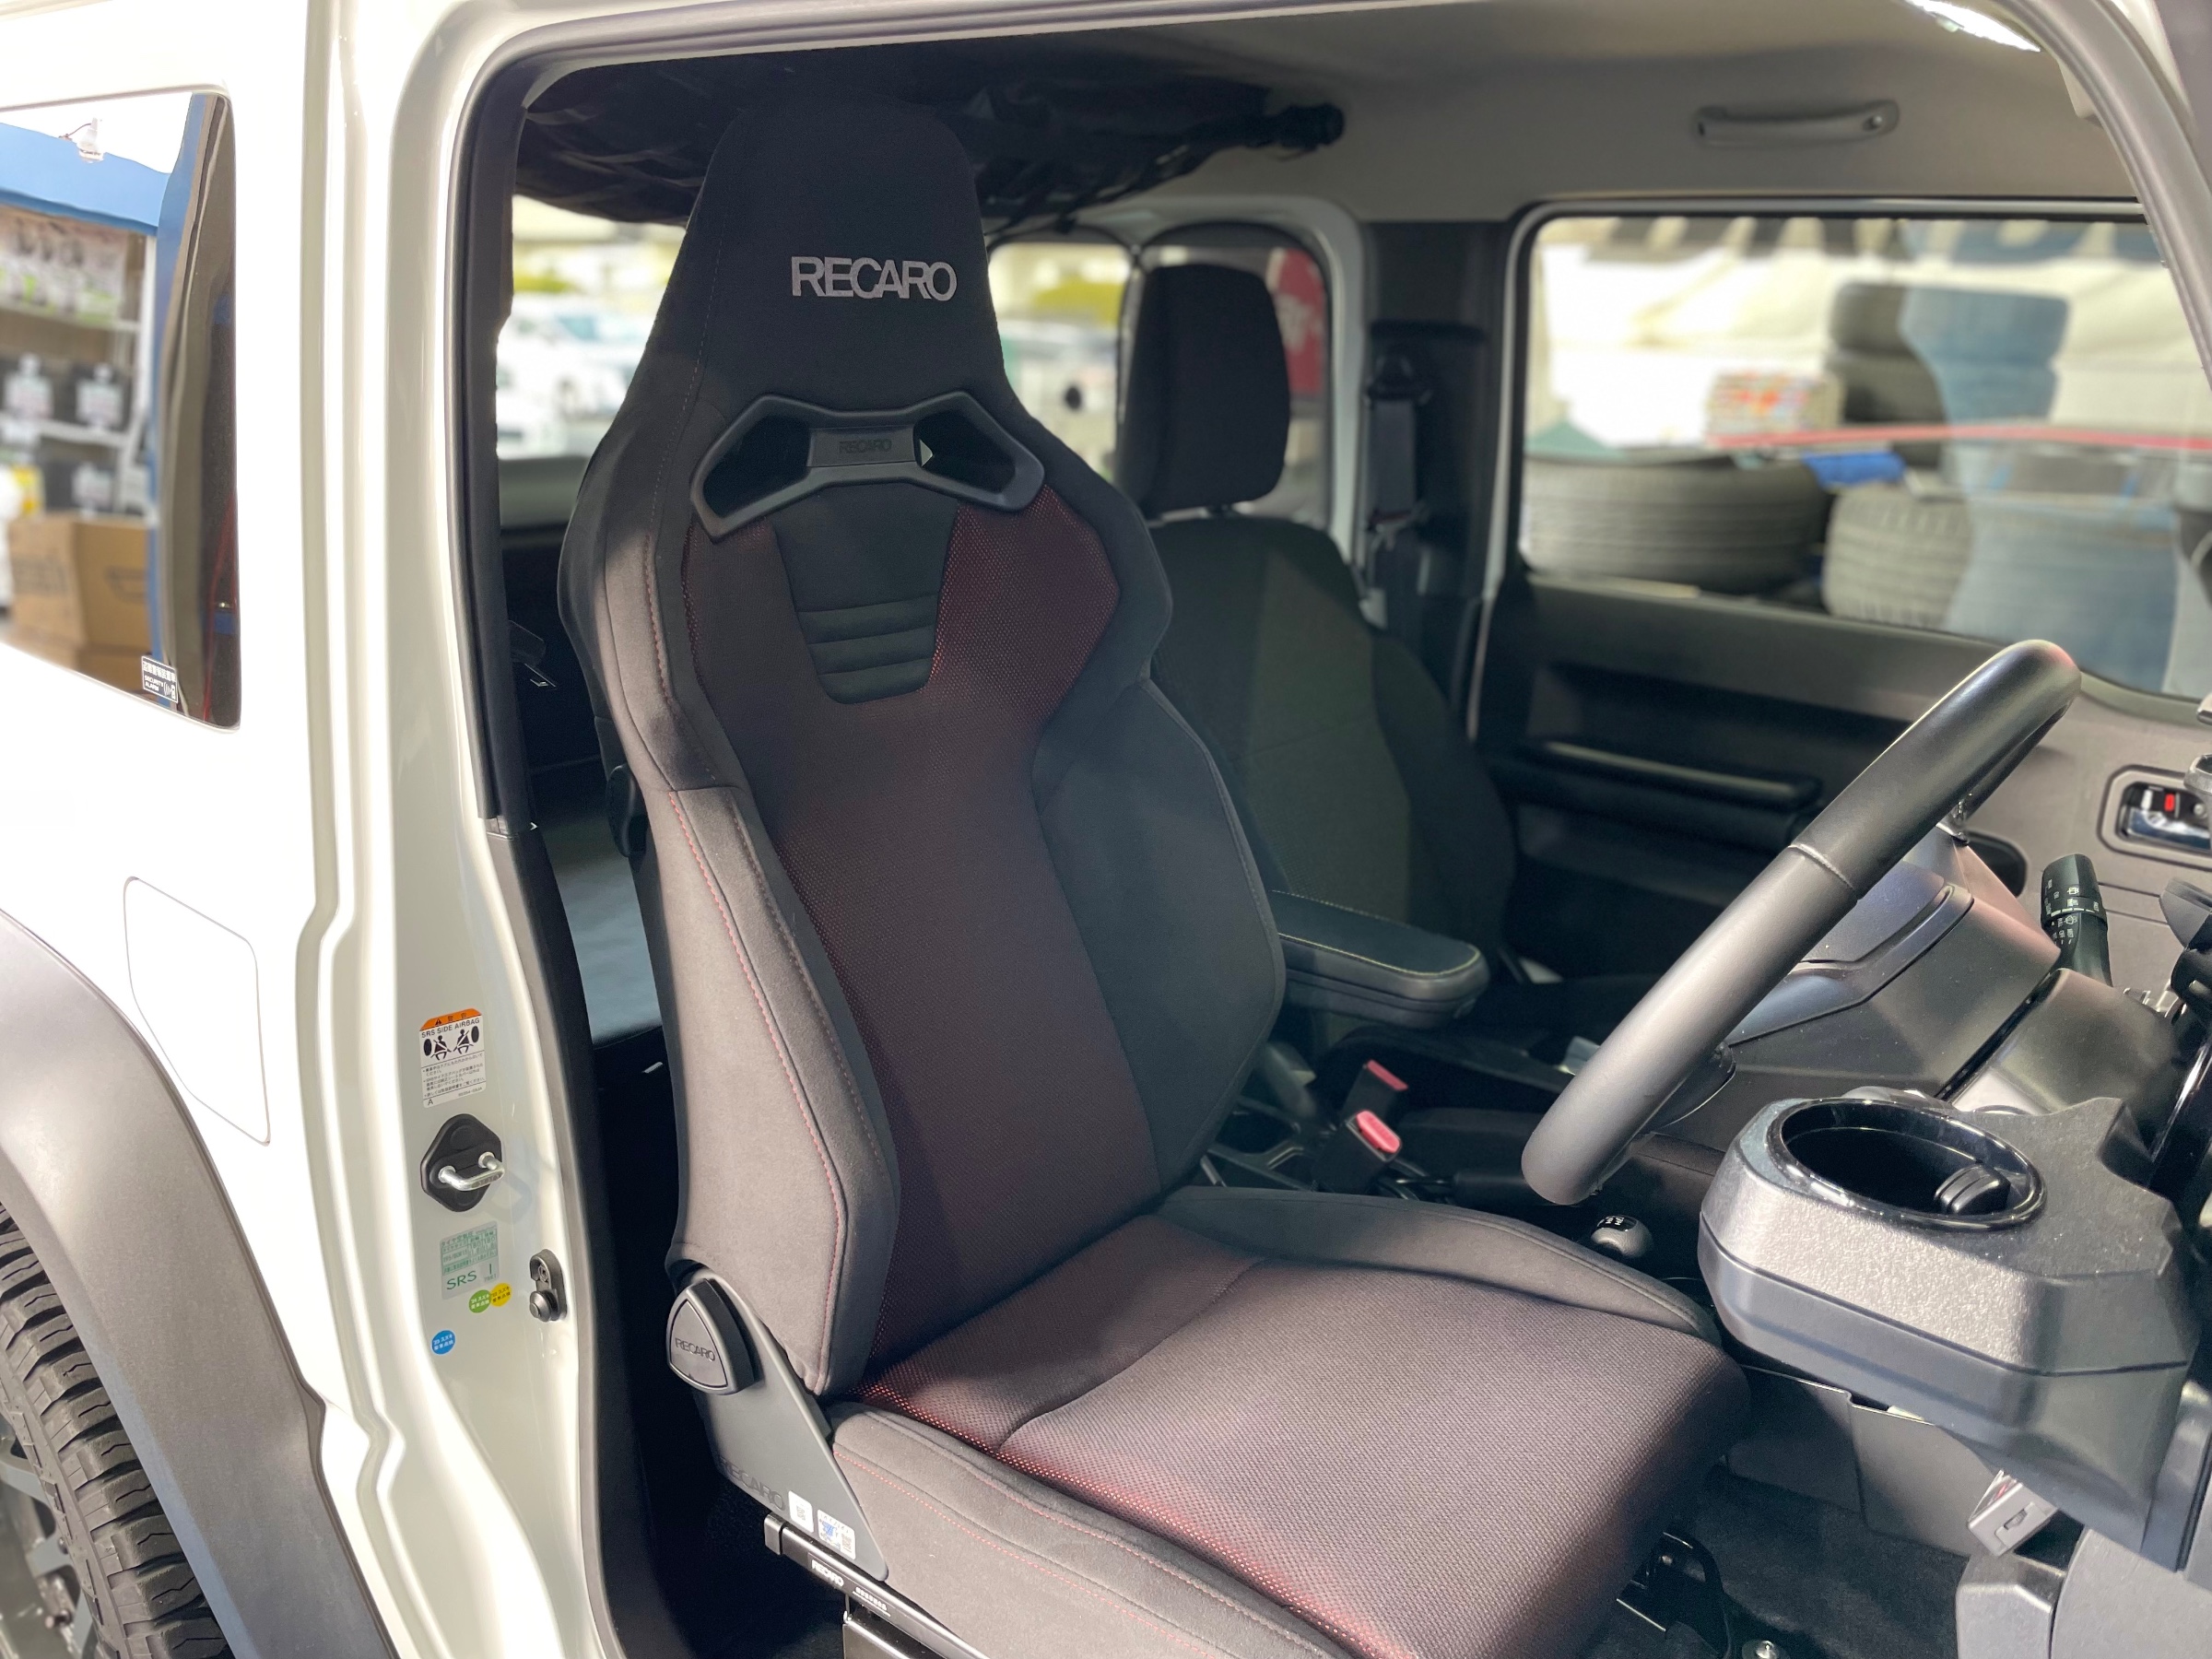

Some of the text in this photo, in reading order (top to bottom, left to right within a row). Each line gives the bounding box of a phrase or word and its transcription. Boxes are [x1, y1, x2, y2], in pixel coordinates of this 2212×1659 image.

[791, 255, 958, 301] RECARO
[838, 438, 893, 454] RECARO
[421, 1018, 480, 1039] SRS SIDE AIRBAG
[446, 1270, 477, 1290] SRS
[674, 1336, 716, 1362] RECARO
[718, 1455, 785, 1512] RECARO
[811, 1559, 844, 1587] RECARO
